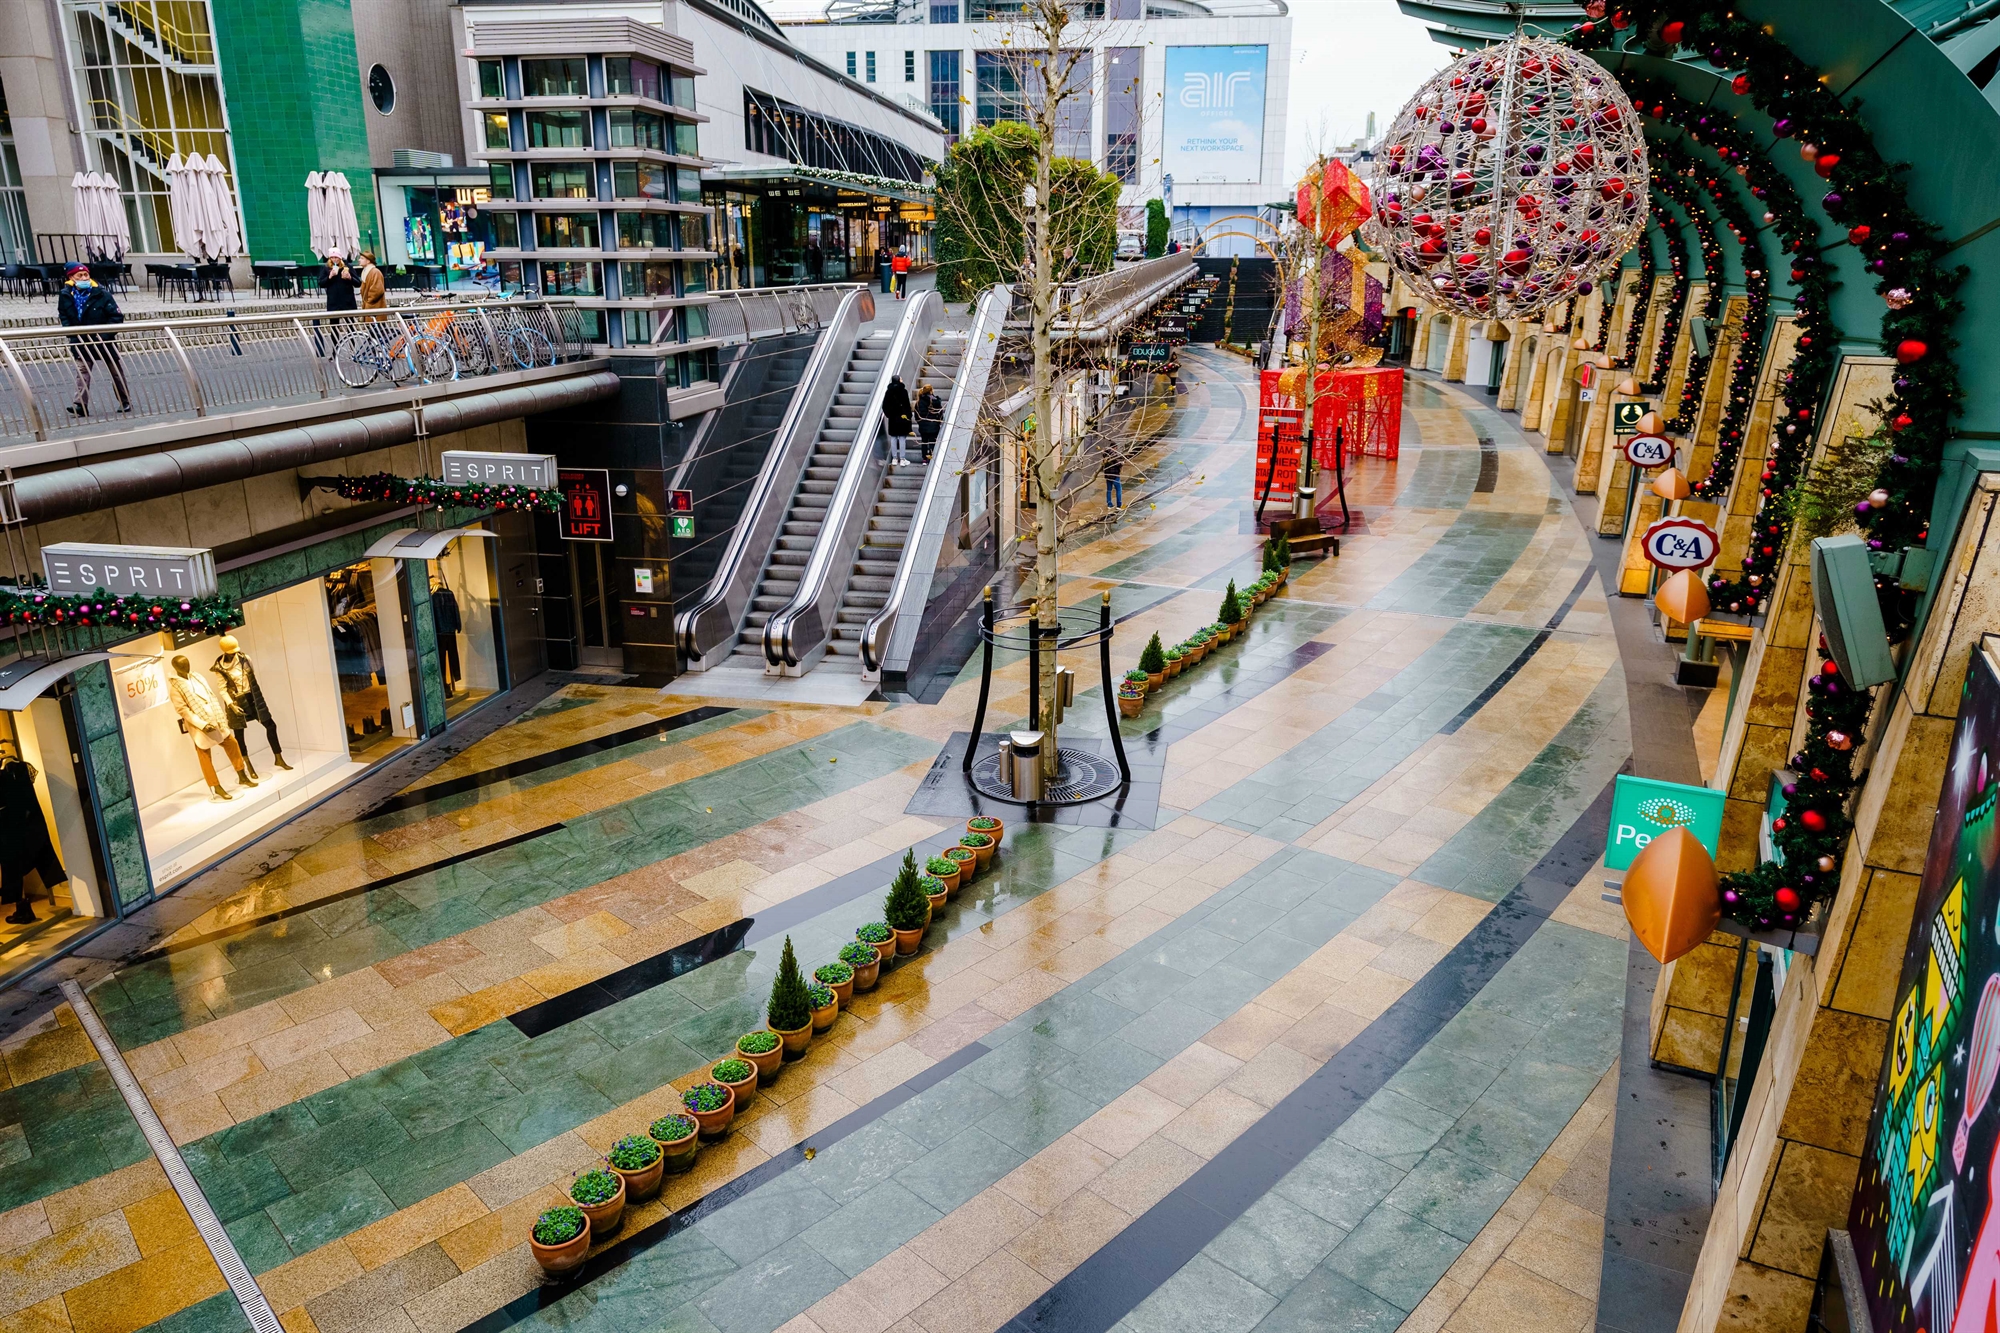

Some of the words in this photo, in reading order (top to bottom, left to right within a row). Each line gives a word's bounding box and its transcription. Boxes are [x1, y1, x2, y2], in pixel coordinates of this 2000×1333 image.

[456, 188, 489, 205] WE
[1132, 348, 1166, 356] DOUGLAS
[1632, 442, 1666, 460] C&A
[450, 462, 541, 481] ESPRIT
[570, 522, 601, 536] LIFT
[1655, 533, 1704, 560] C&A
[54, 562, 184, 590] ESPRIT
[127, 673, 159, 700] 50%
[158, 865, 183, 882] esprit.com
